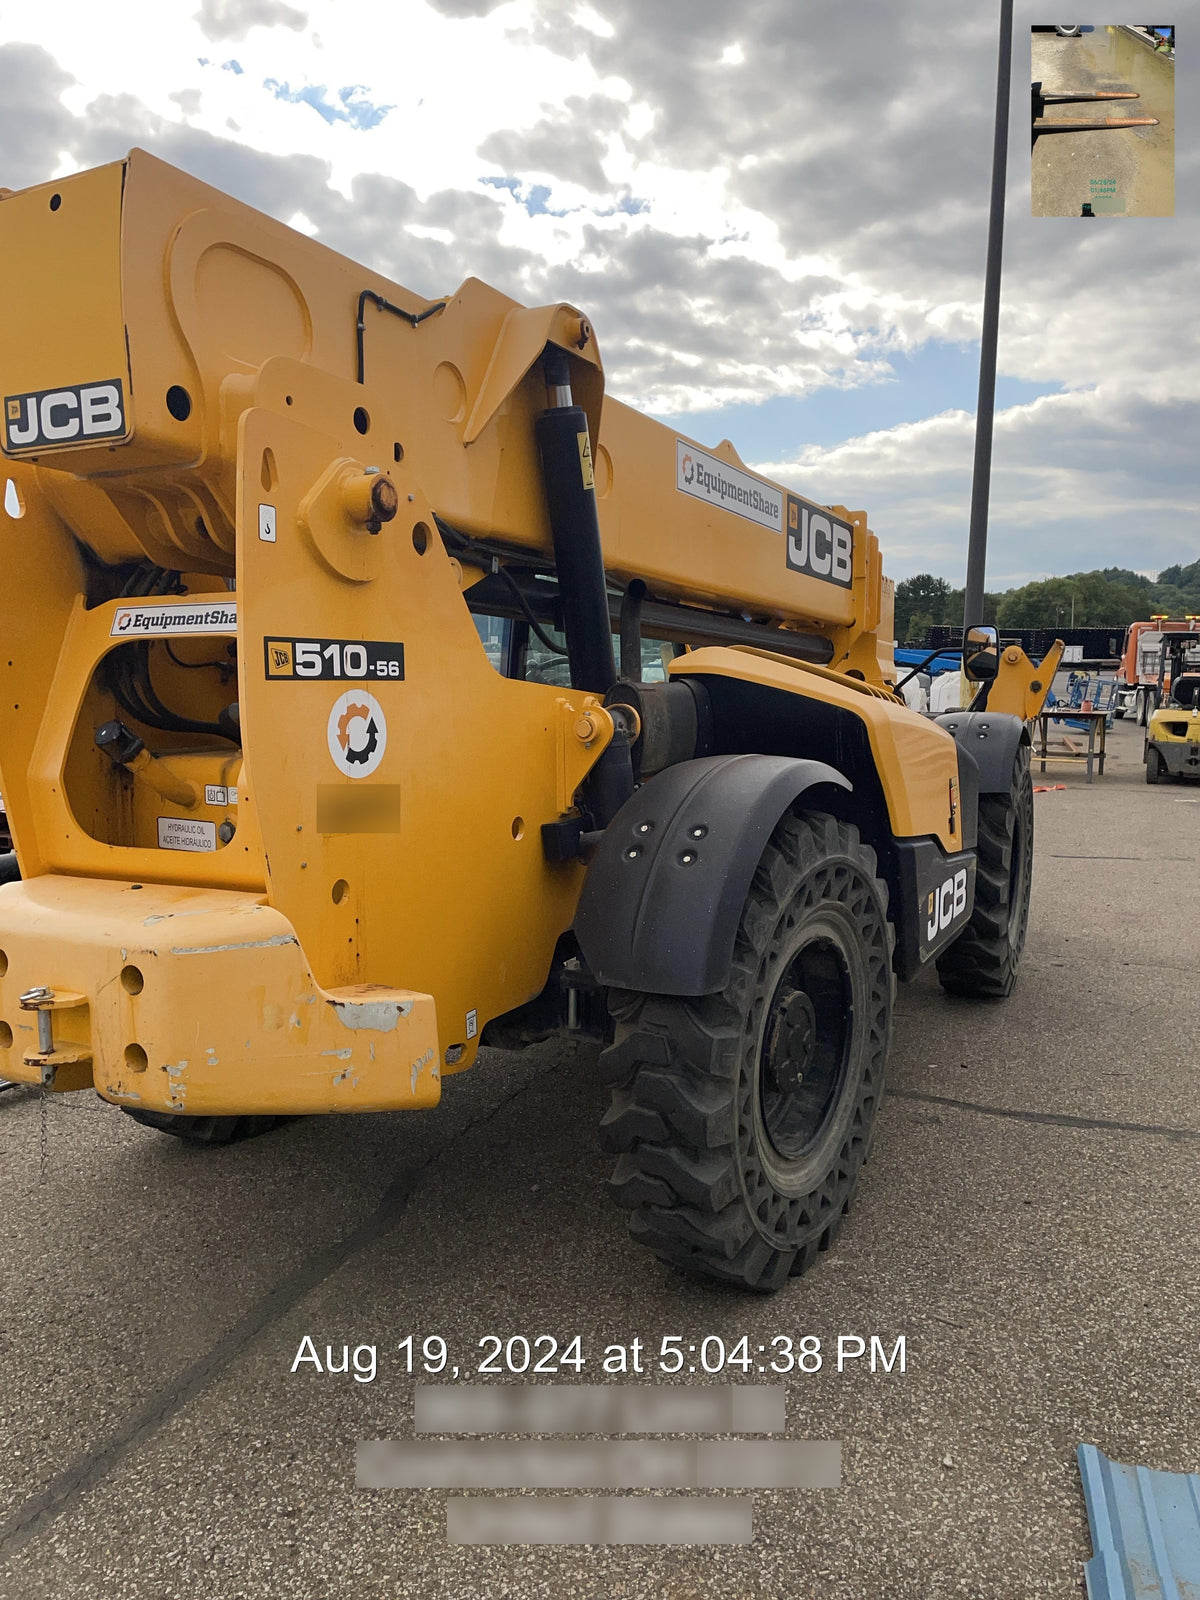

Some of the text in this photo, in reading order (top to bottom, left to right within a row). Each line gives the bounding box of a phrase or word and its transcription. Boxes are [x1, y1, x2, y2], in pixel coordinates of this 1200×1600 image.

[9, 385, 122, 444] JCB
[696, 462, 779, 519] EquipmentShare
[788, 508, 852, 582] JCB
[133, 610, 237, 630] EquipmentSha
[273, 650, 290, 667] JCB
[162, 835, 181, 845] ACEITE
[167, 823, 206, 835] HYDRAULIC OIL
[927, 868, 967, 941] JCB
